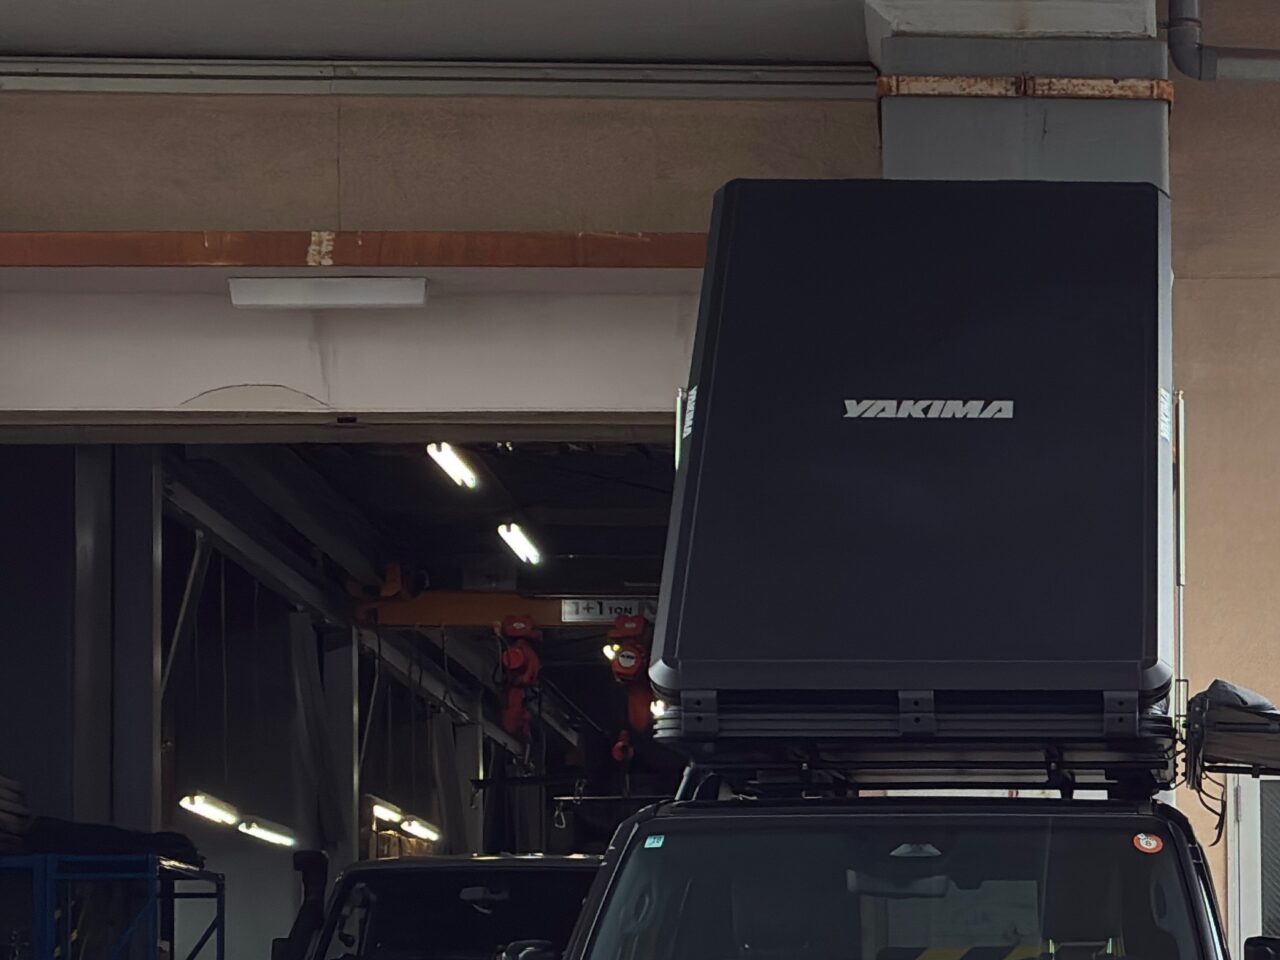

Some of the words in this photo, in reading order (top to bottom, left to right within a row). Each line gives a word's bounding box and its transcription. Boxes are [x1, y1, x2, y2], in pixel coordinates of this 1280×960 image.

[843, 399, 1014, 418] YAKIMA
[571, 601, 603, 615] 1+1
[608, 606, 633, 615] TON
